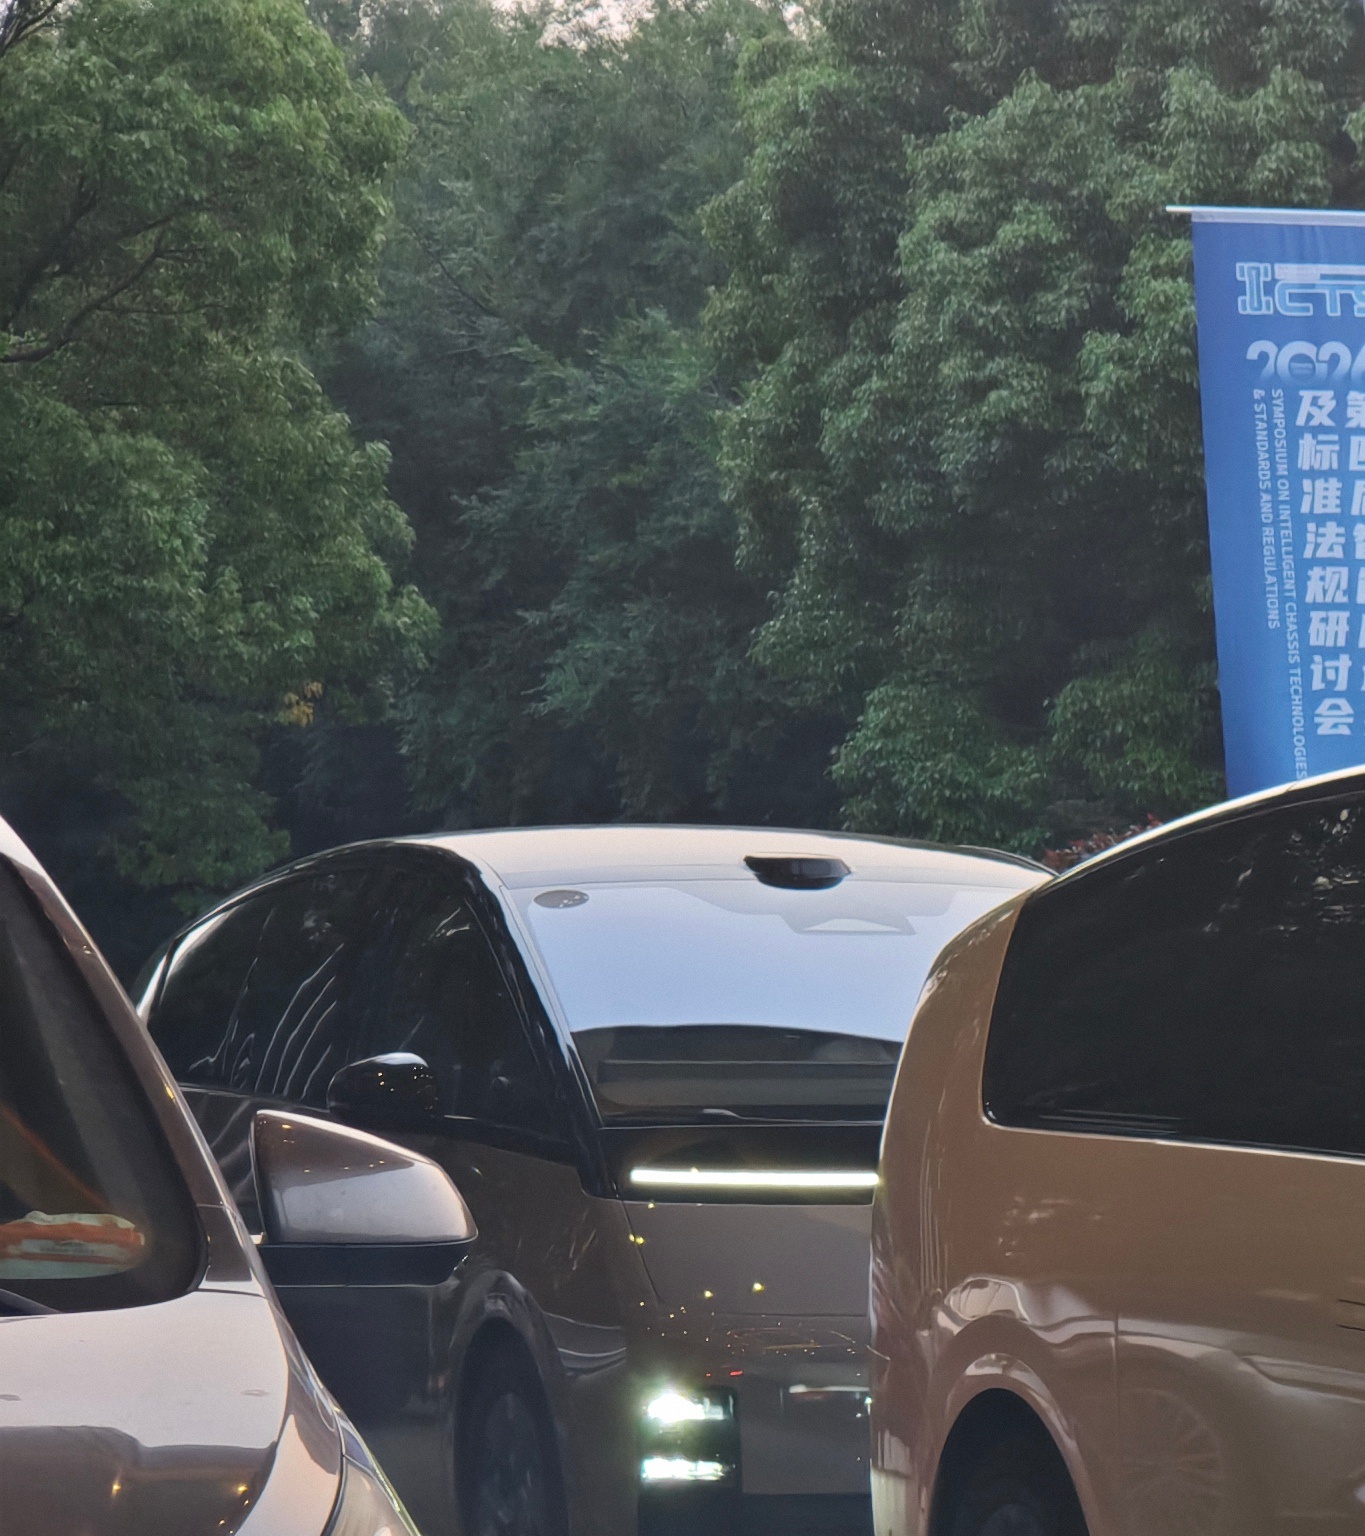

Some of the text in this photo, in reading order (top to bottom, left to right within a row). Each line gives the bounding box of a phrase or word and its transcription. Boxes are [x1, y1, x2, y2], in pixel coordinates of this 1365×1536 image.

[1254, 403, 1272, 490] STANDARDS
[1260, 493, 1273, 524] AND
[1262, 526, 1281, 630] REGULATIONS
[1271, 388, 1308, 779] SYMPOSIUM ON INTELLIGENT CHASSIS TECHNOLOGIES
[1295, 388, 1354, 736] 及标准法规研讨会
